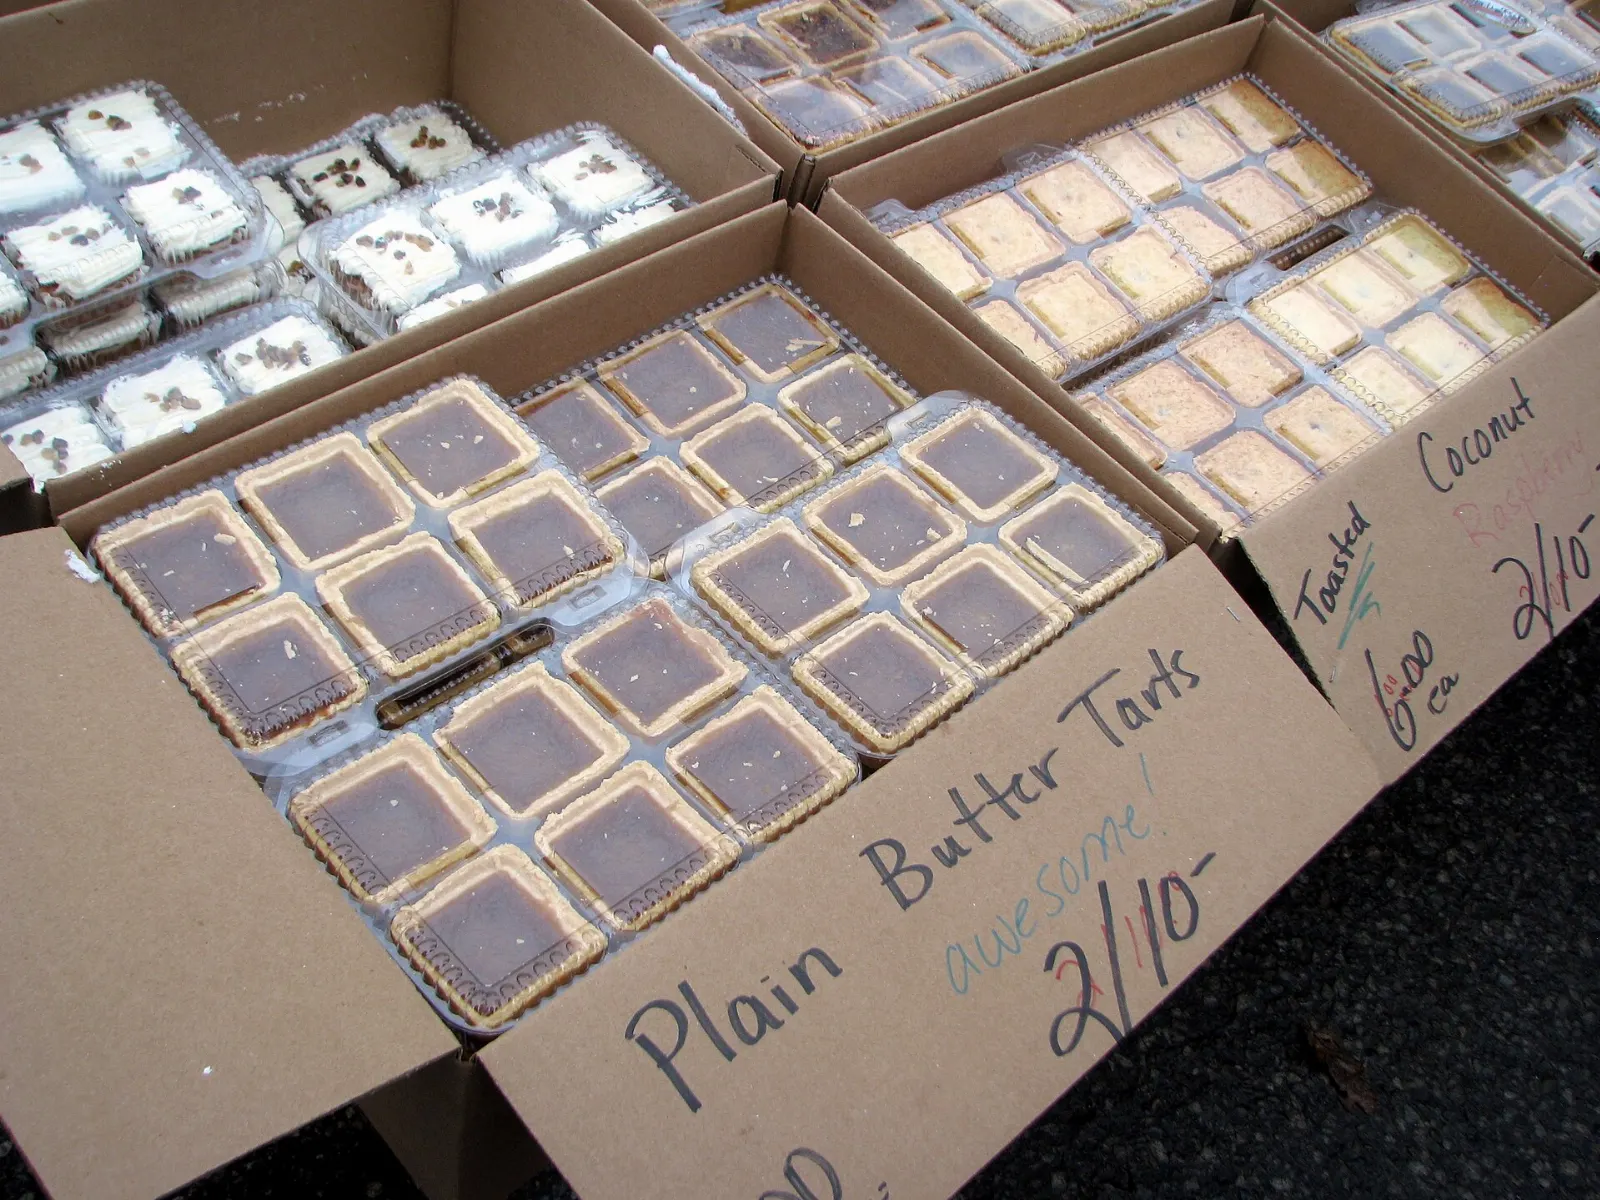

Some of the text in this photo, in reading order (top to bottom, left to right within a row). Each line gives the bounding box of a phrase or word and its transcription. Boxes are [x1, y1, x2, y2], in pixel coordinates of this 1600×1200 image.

[1294, 377, 1535, 625] Toasted Coconut
[625, 648, 1200, 1113] Plain Butter Tarts
